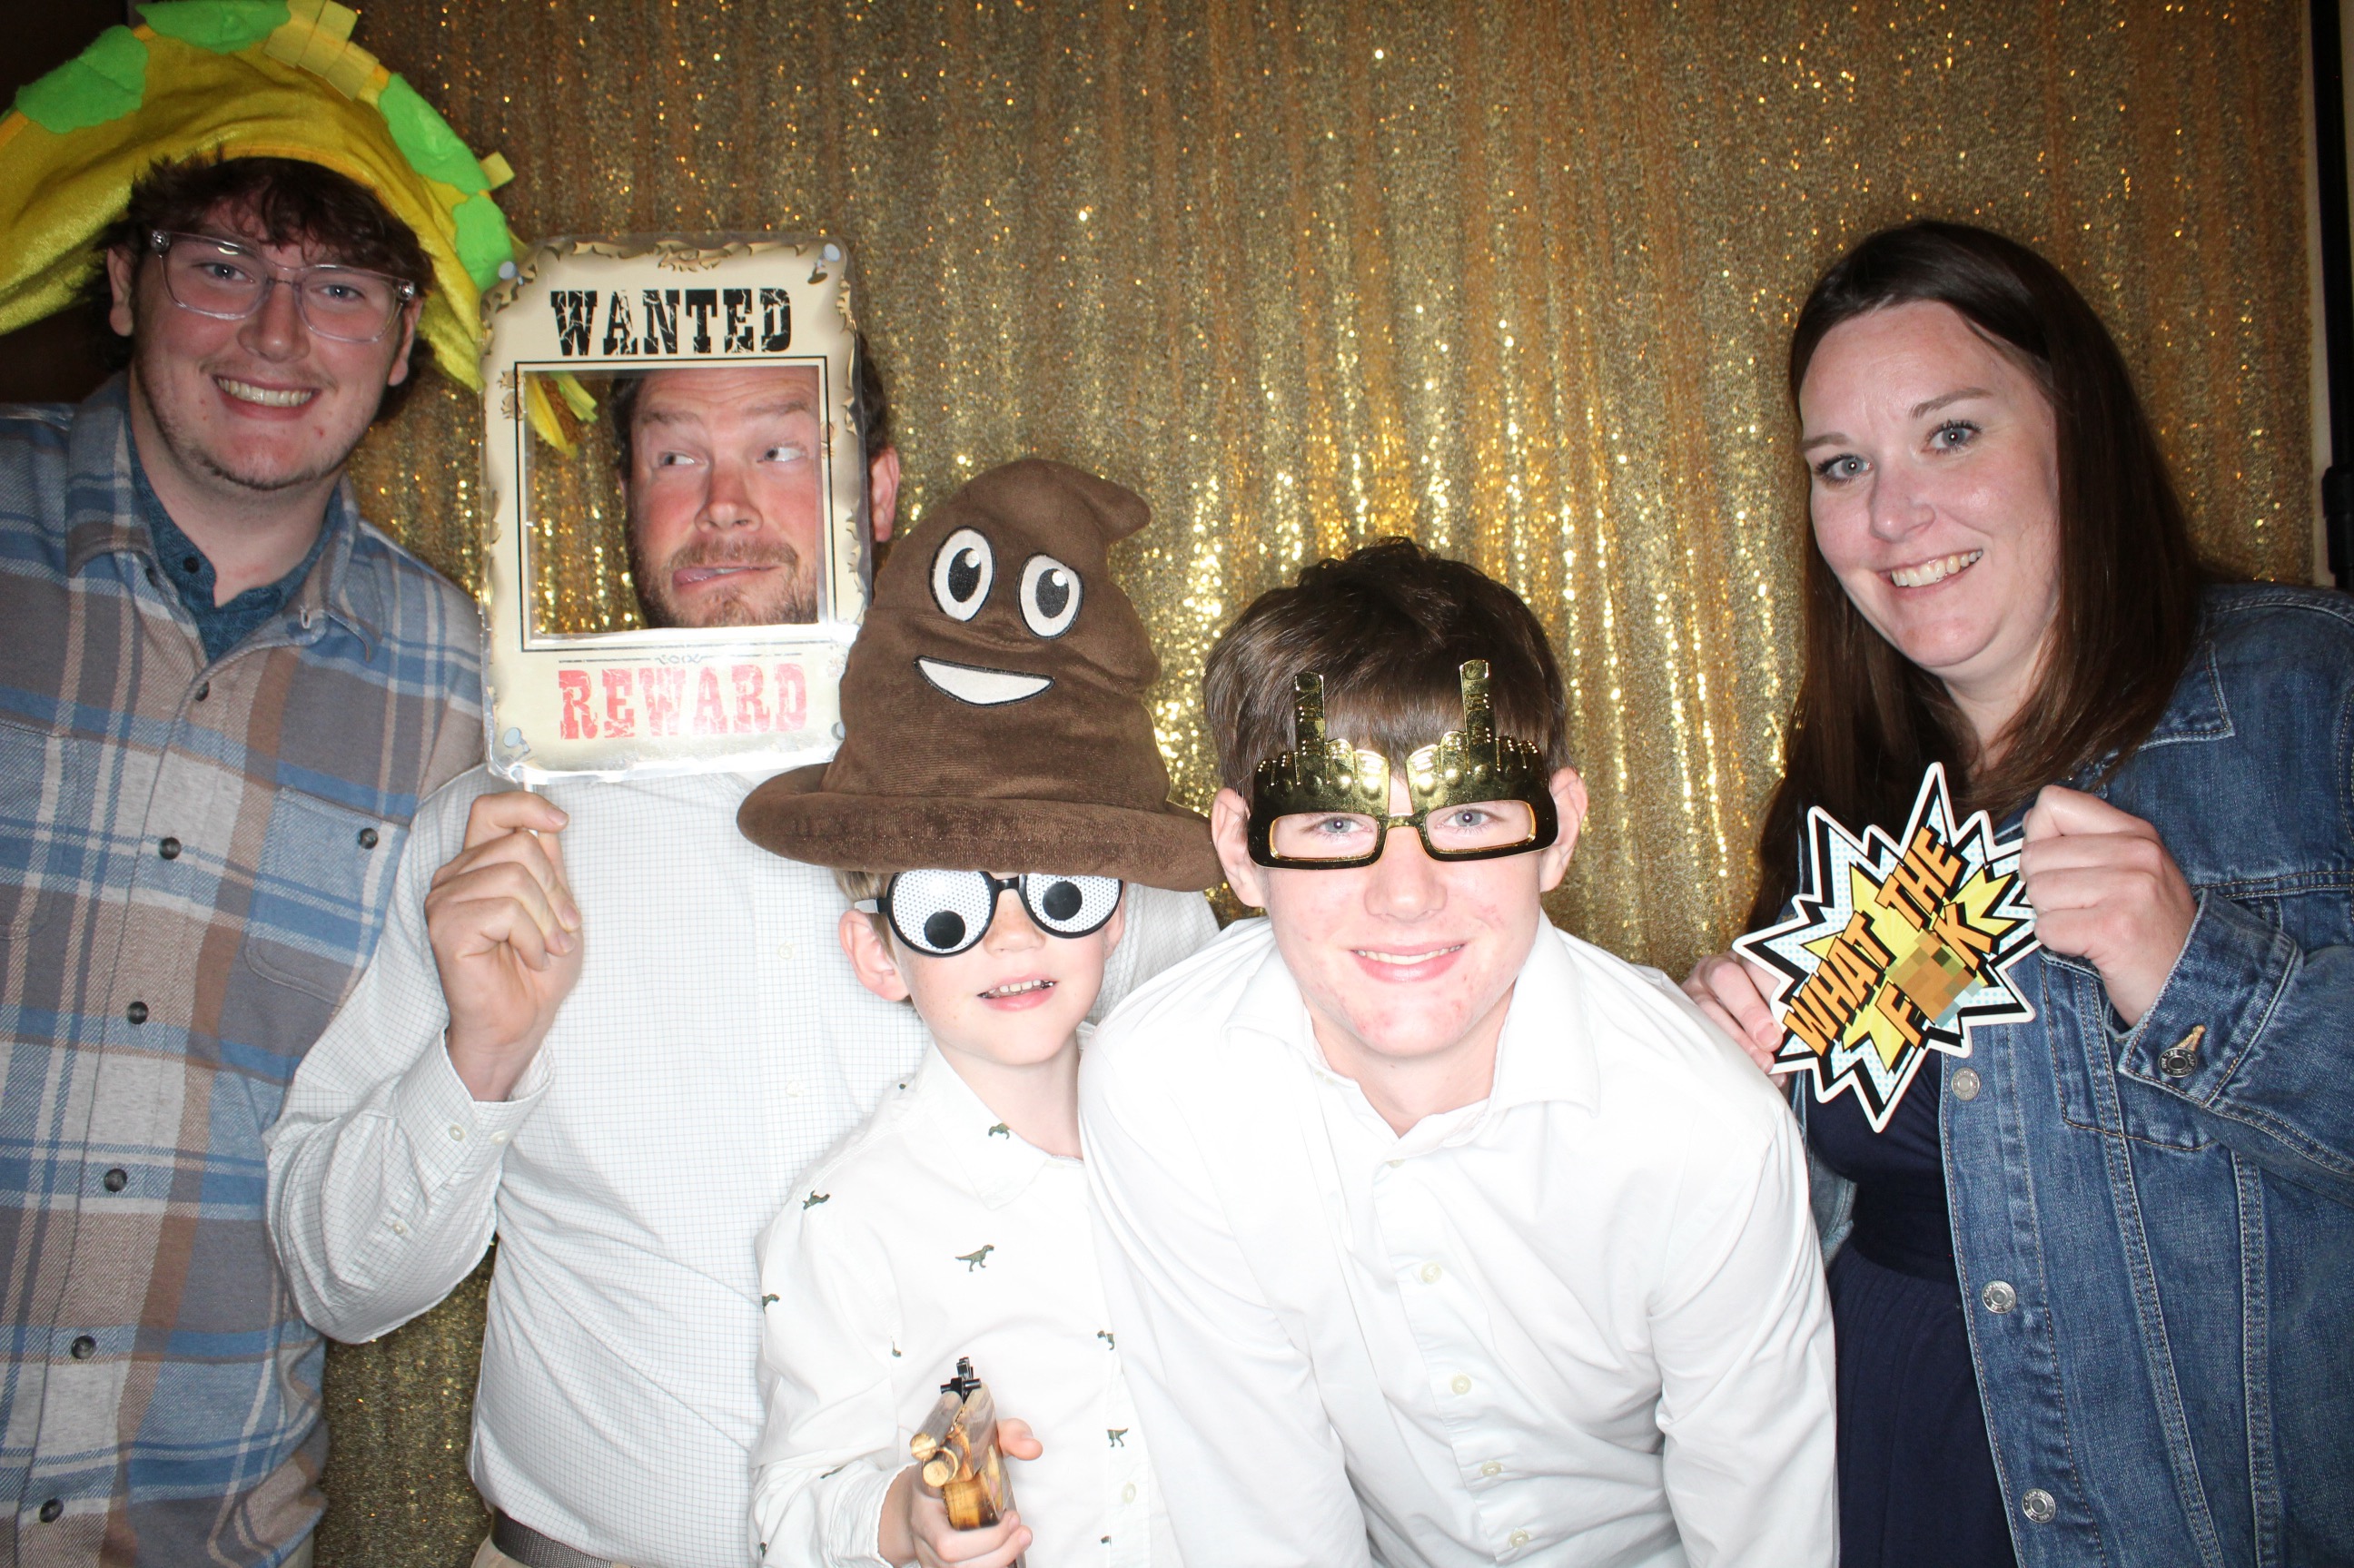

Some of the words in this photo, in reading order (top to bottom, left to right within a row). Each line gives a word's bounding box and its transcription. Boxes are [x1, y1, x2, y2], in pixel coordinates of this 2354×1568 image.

[549, 288, 792, 356] WANTED
[559, 663, 806, 739] REWARD
[1783, 911, 1889, 1056] WHAT
[1874, 826, 1962, 930] THE
[1875, 902, 1993, 1048] FK
